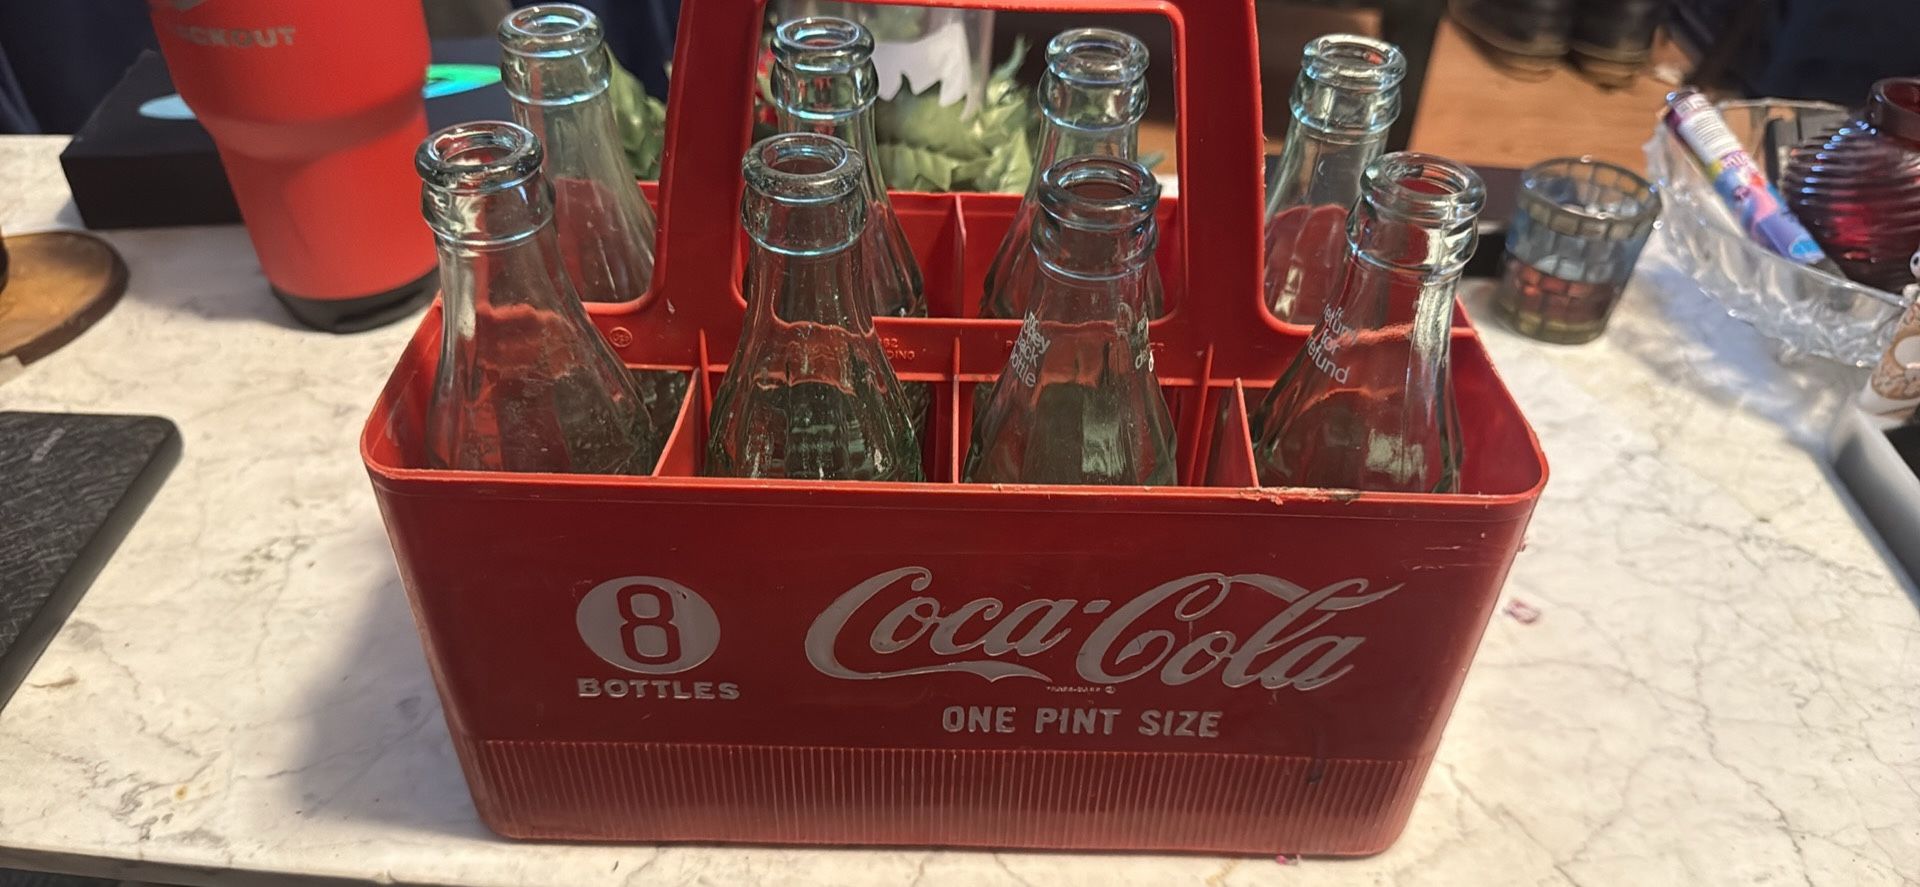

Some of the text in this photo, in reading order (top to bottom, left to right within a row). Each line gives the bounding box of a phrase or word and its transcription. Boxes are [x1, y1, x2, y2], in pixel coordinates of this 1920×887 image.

[1321, 327, 1341, 355] for
[616, 583, 682, 665] 8
[805, 566, 1404, 692] Coca-Cola
[577, 677, 741, 700] BOTTLES
[942, 705, 1223, 738] ONE PINT SIZE
